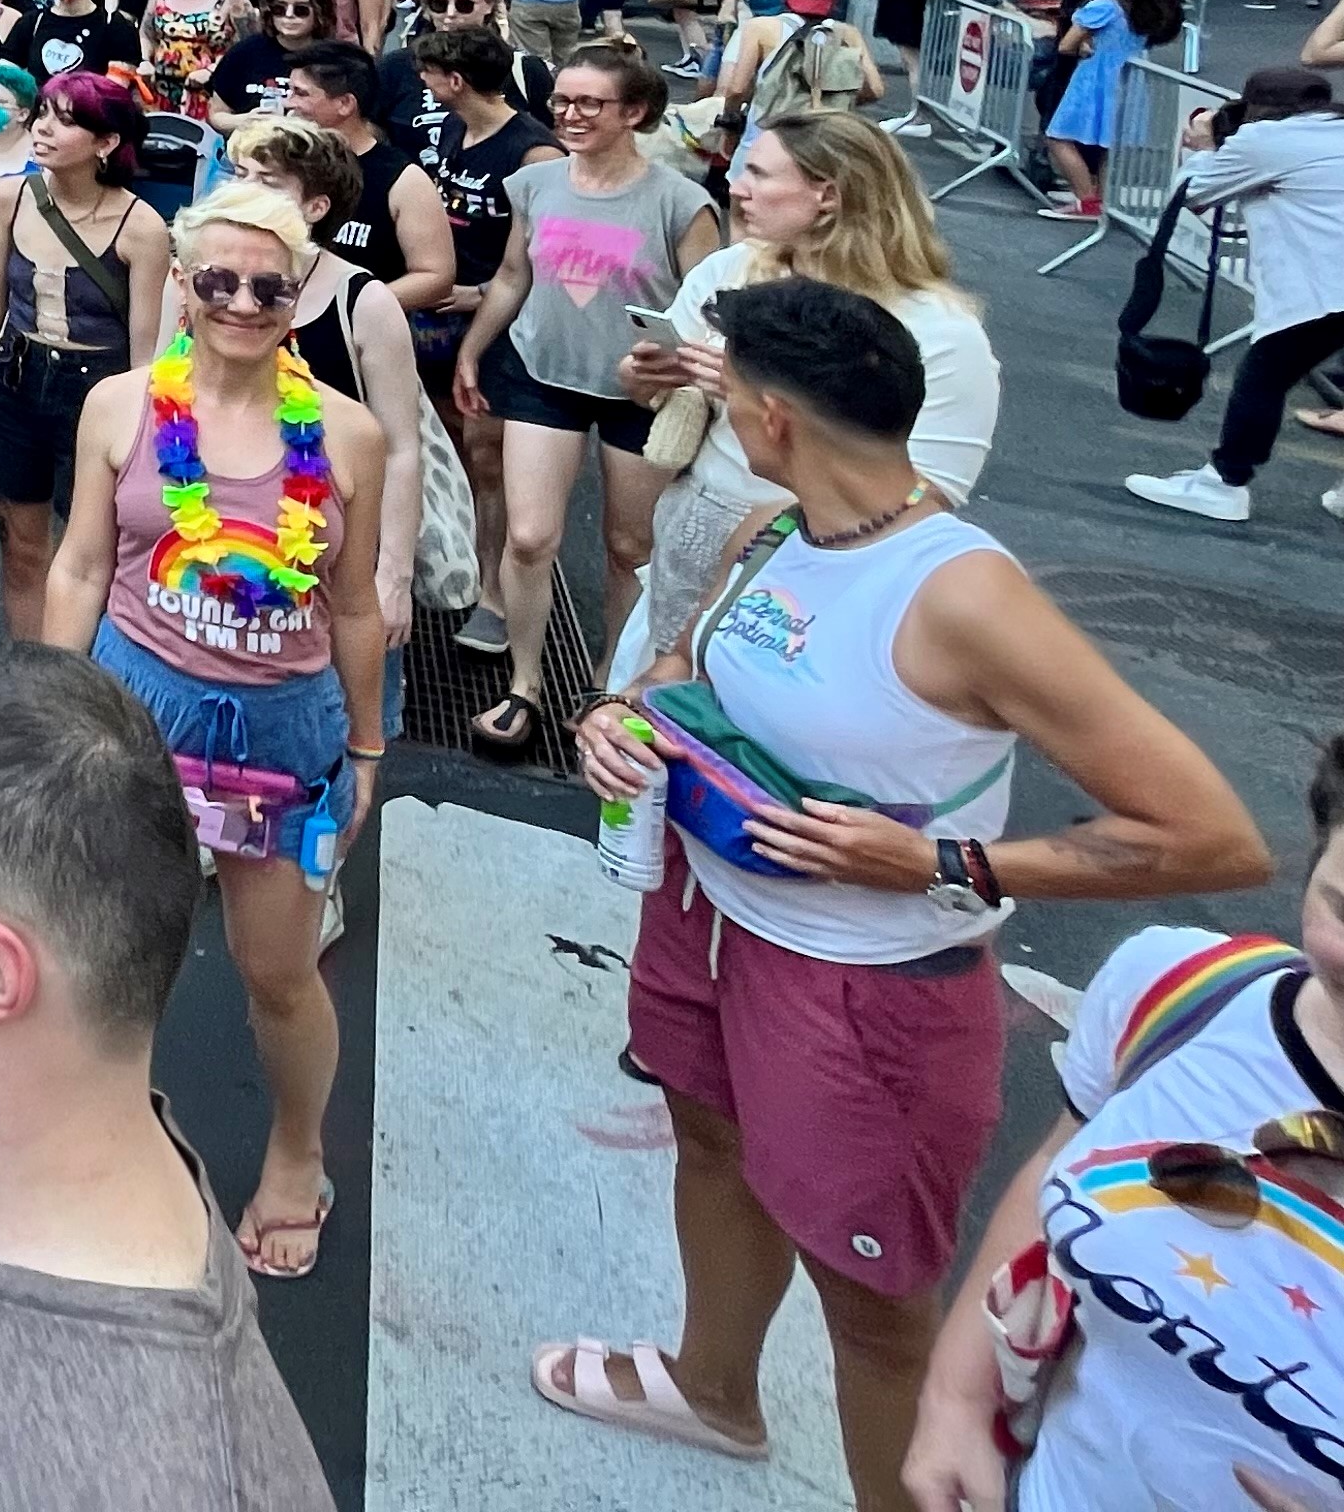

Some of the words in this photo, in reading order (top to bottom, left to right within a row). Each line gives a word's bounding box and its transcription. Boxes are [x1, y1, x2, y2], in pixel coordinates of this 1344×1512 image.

[45, 49, 71, 64] DYKE
[331, 221, 372, 248] ATH
[269, 607, 313, 633] GAY
[734, 589, 817, 636] Eternal
[184, 618, 238, 650] I'M
[246, 631, 282, 654] IN
[716, 620, 806, 663] Optimist
